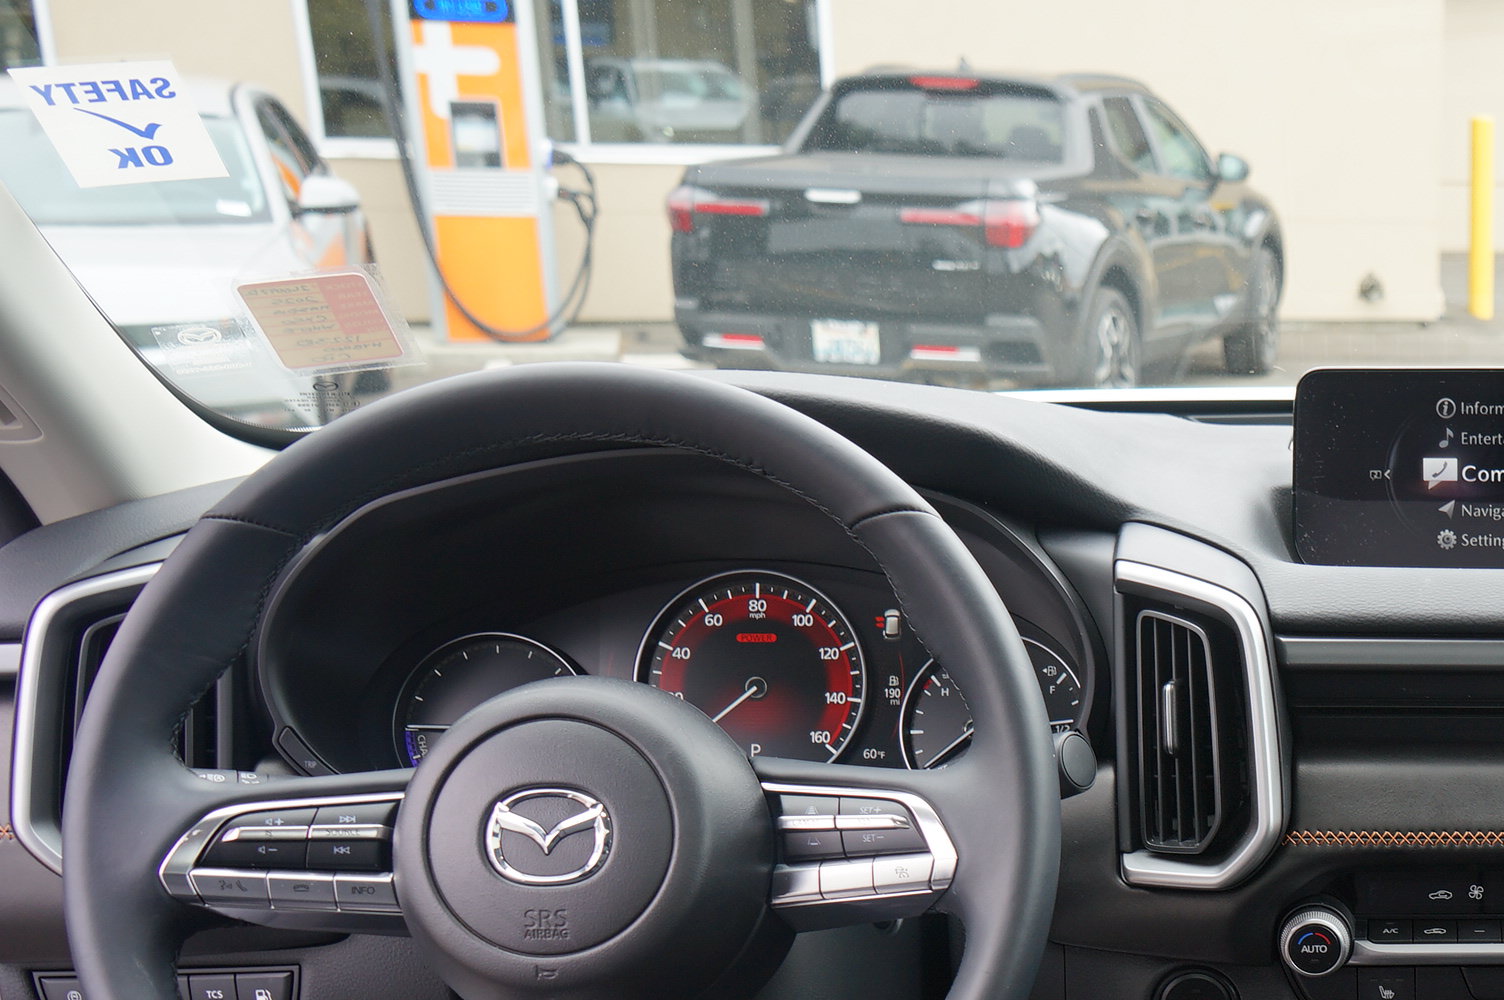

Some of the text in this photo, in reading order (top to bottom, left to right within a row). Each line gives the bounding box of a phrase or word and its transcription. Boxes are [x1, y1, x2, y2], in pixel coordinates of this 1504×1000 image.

[748, 600, 767, 613] 80
[704, 614, 723, 627] 60
[791, 614, 814, 627] 100
[741, 634, 773, 643] POWER
[672, 647, 691, 660] 40
[819, 647, 840, 661] 120
[884, 688, 901, 698] 190
[940, 687, 949, 697] H
[1049, 685, 1056, 695] F
[825, 692, 846, 704] 140
[809, 730, 831, 744] 160
[750, 744, 761, 758] P
[304, 760, 317, 769] TRIP
[351, 885, 375, 895] INFO
[524, 908, 567, 928] SRS
[524, 928, 570, 939] AIRBAG
[1301, 944, 1328, 954] AUTO
[206, 990, 224, 999] TCS
